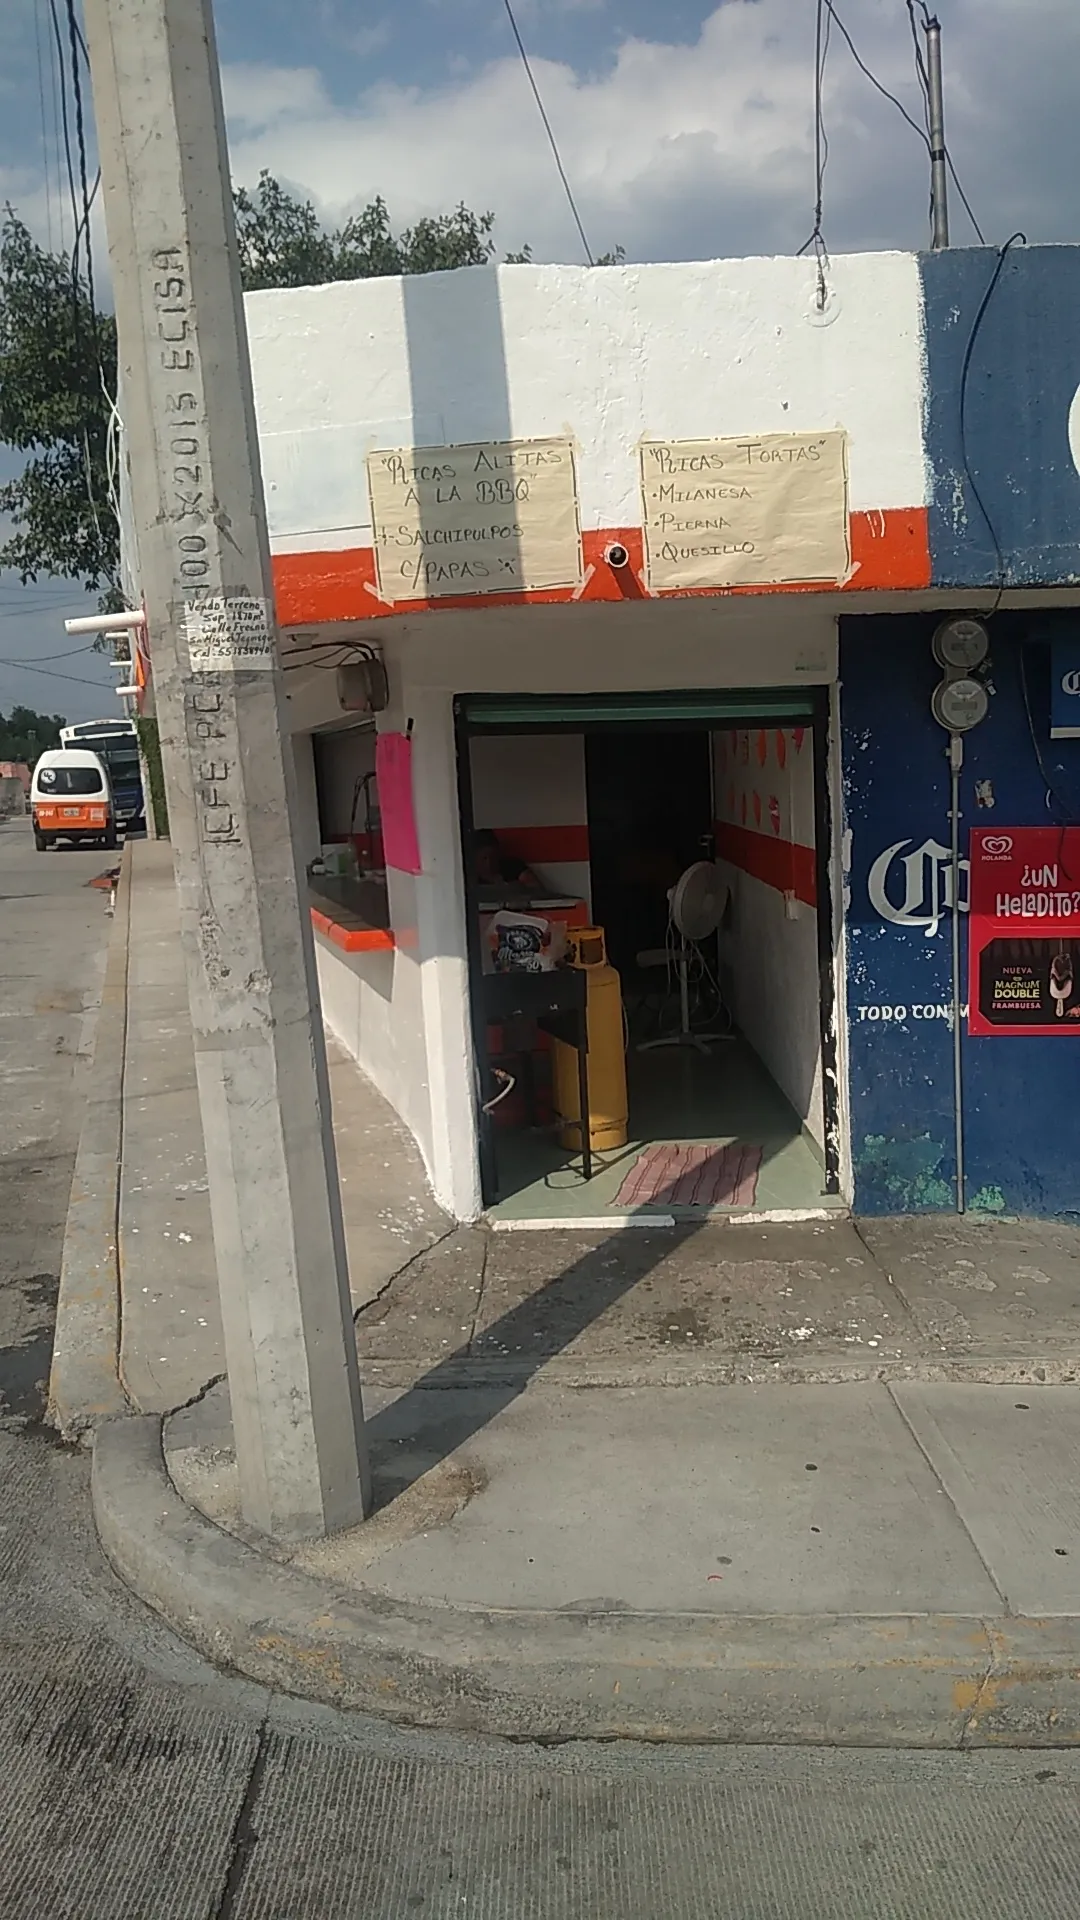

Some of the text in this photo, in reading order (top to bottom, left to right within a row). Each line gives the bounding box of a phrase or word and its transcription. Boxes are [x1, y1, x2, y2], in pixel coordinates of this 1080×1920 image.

[474, 450, 562, 472] ALITAS
[404, 488, 422, 507] A
[436, 485, 461, 503] LA
[659, 483, 752, 504] MILANESA
[660, 512, 732, 533] PIERNA
[396, 525, 525, 547] SALCHIPULPOS
[662, 541, 755, 564] QUESILLO
[188, 598, 260, 613] Vendo Terreno
[994, 980, 1040, 989] MAGNUM
[994, 988, 1040, 999] DOUBLE
[857, 1005, 907, 1020] TODO
[911, 1004, 948, 1019] CON
[991, 1002, 1042, 1010] FRAMBUESA
